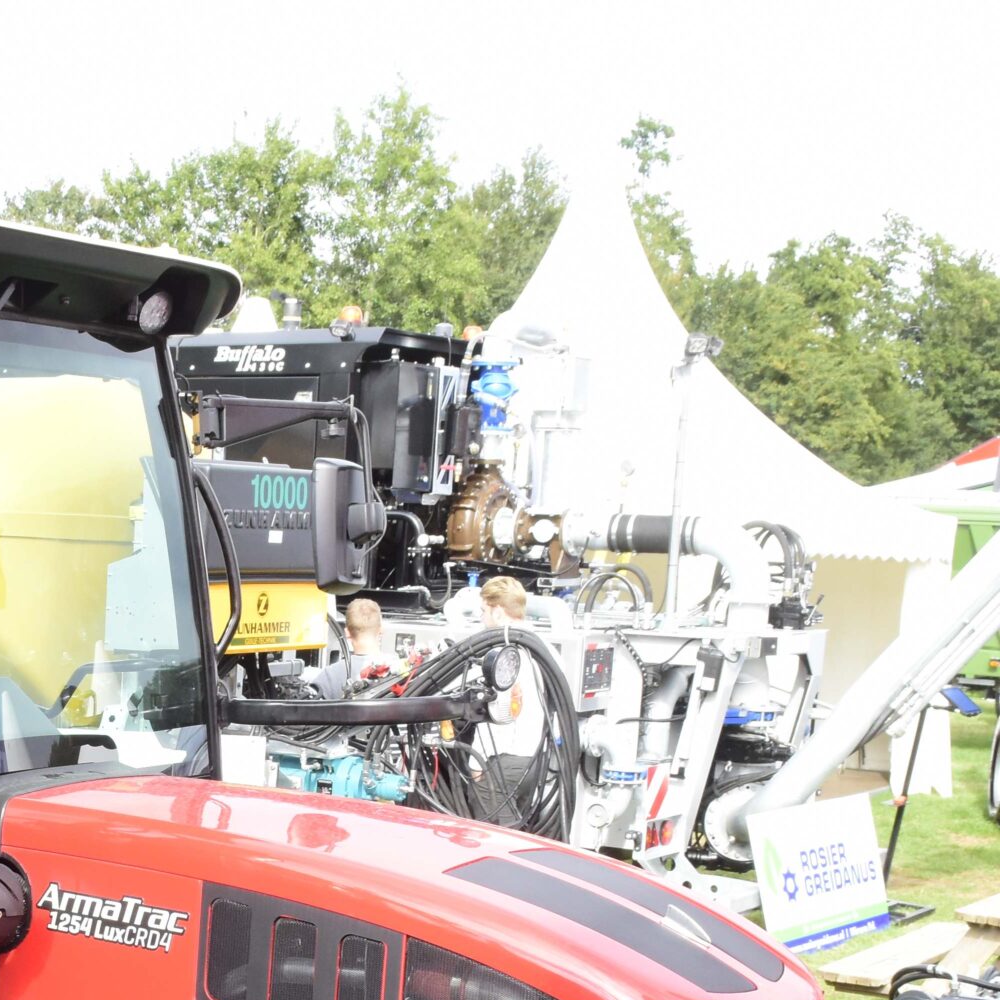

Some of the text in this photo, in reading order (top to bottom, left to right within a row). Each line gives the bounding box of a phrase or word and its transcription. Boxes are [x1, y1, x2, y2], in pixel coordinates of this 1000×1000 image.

[214, 345, 286, 372] Buffalo
[251, 474, 308, 510] 10000
[799, 843, 848, 871] ROSIER
[803, 860, 877, 897] GREIDANUS
[37, 882, 189, 934] ArmaTrac
[47, 911, 94, 937] 1254
